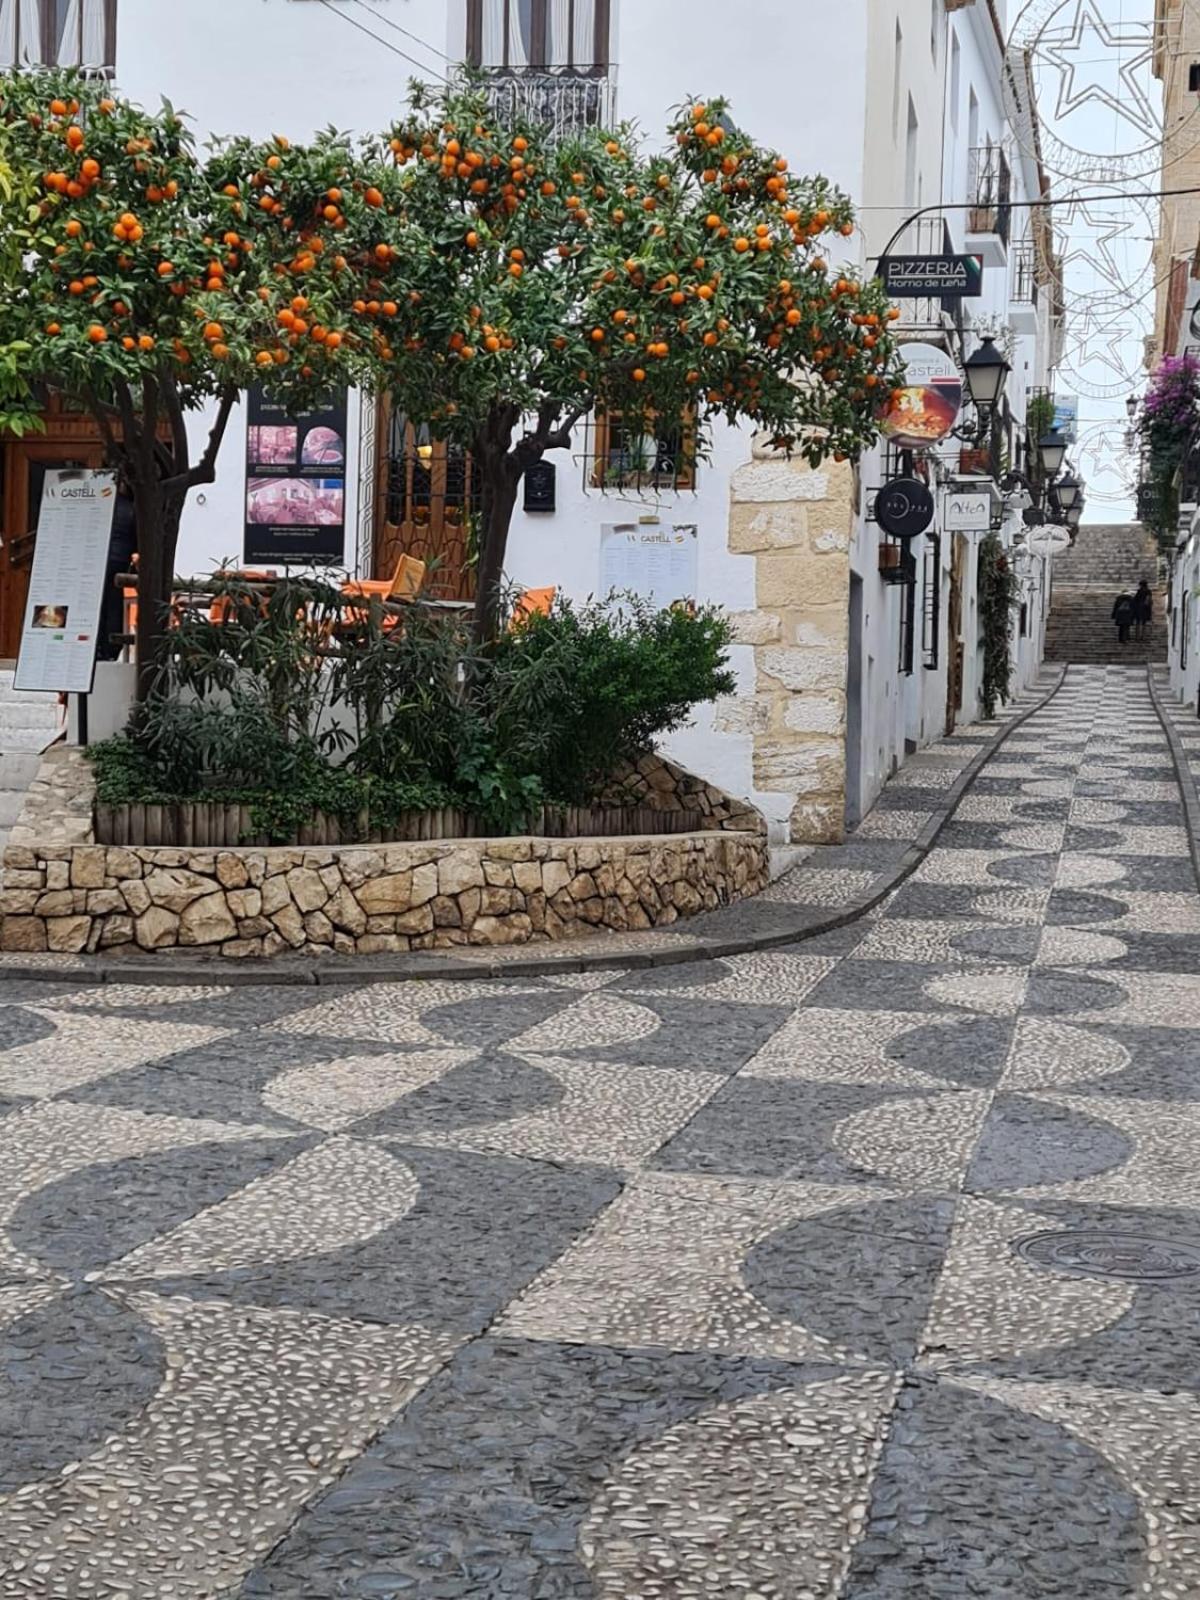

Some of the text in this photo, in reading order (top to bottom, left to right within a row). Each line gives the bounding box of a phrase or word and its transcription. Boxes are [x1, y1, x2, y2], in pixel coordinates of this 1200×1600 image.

[888, 261, 967, 275] PIZZERIA
[888, 278, 967, 288] Horno de Leña
[905, 363, 951, 377] astell
[61, 487, 97, 498] CASTELL
[640, 535, 672, 543] CASTELL
